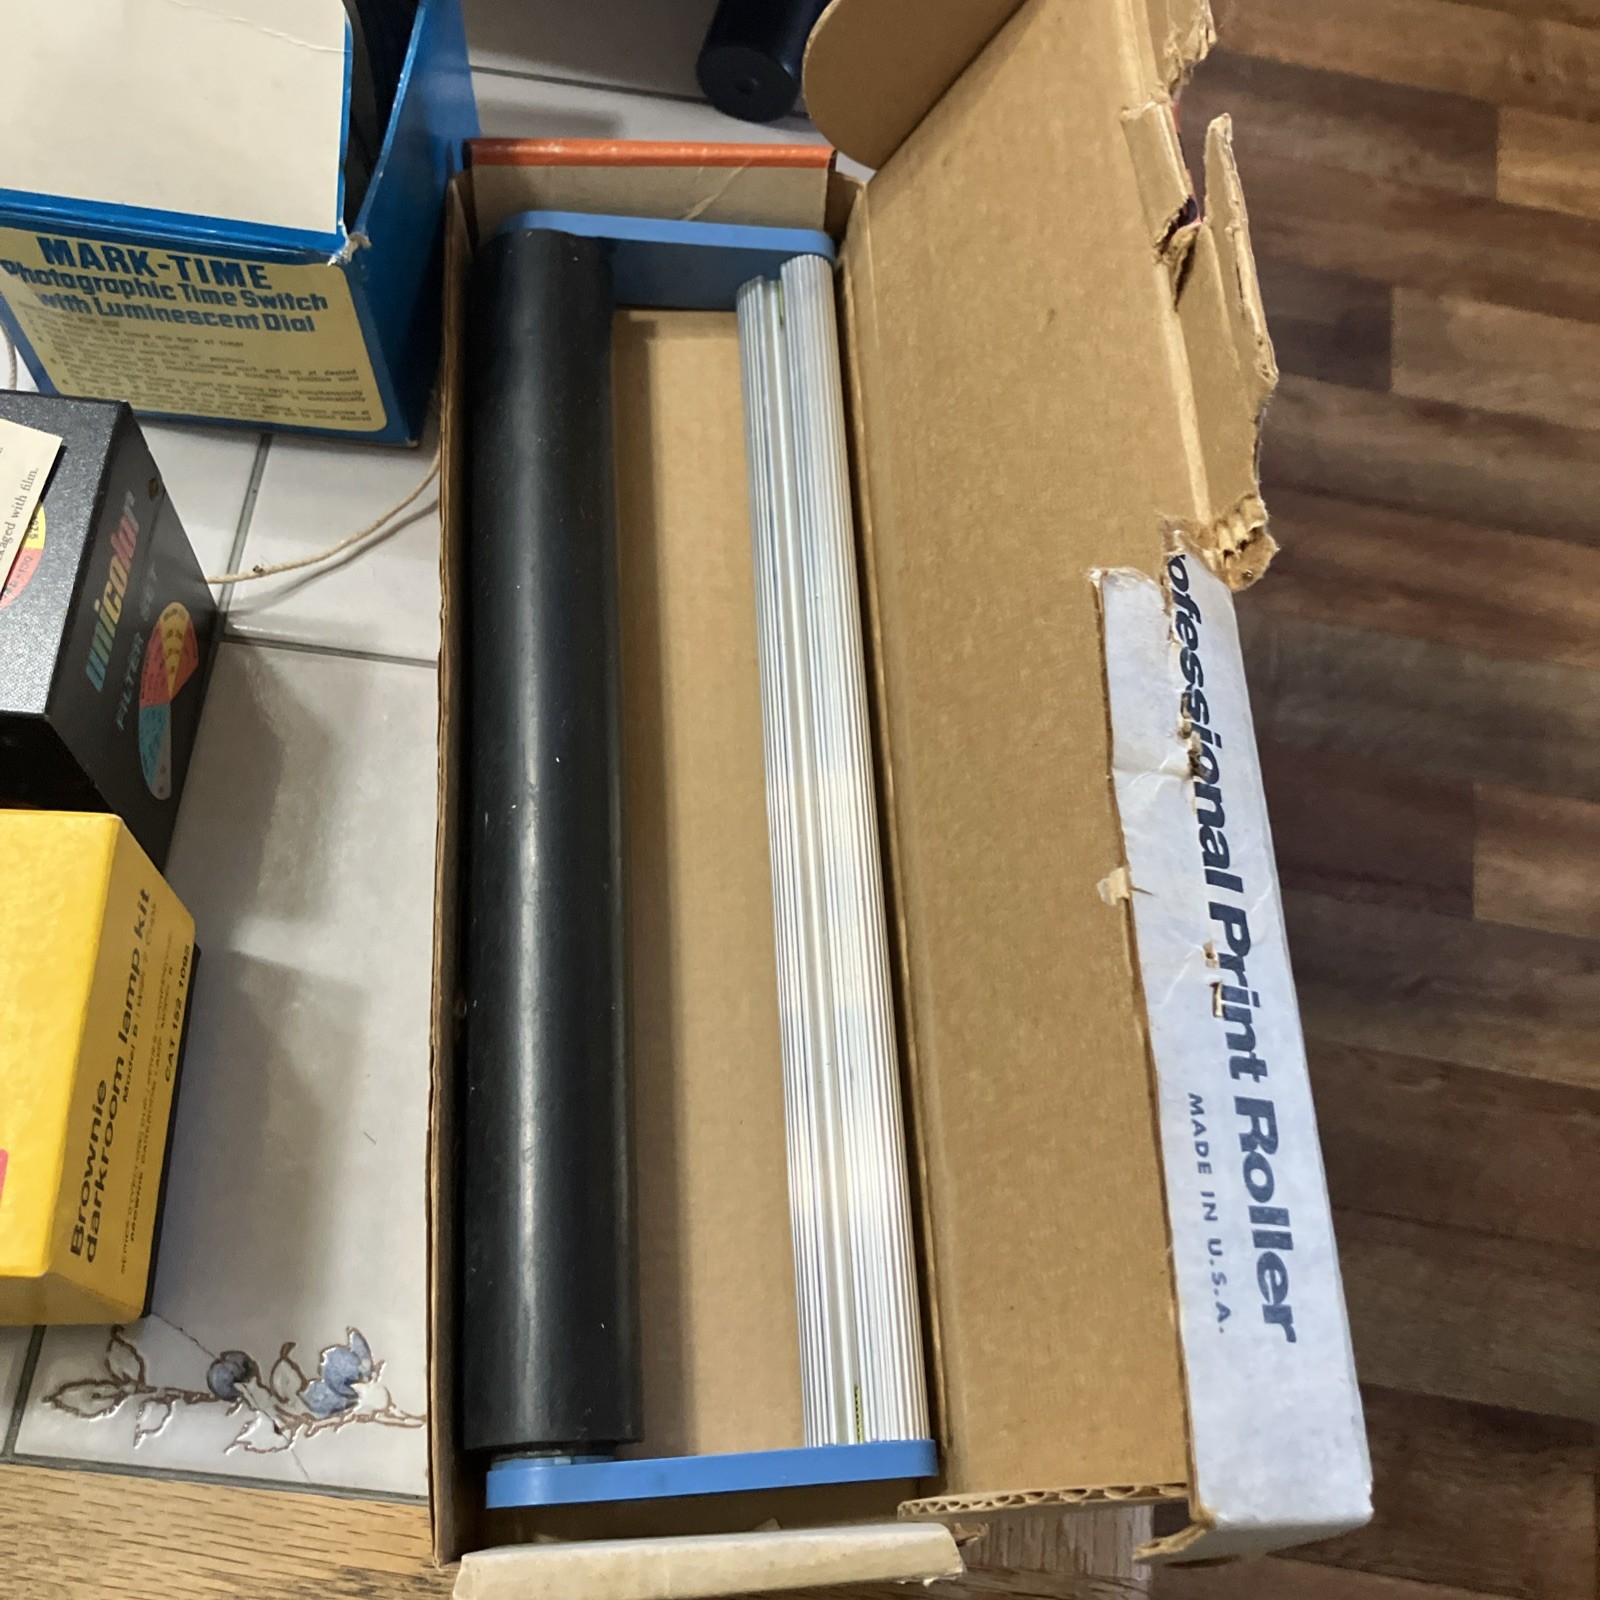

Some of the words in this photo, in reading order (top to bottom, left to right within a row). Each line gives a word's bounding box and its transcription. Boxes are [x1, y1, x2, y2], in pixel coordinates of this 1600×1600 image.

[36, 236, 272, 290] MARK-TIME
[178, 283, 238, 307] Time
[240, 290, 329, 311] Switch
[37, 293, 92, 314] with
[92, 296, 260, 330] Luminescent
[261, 313, 316, 332] Dial
[12, 496, 28, 518] with
[23, 467, 39, 492] film.
[85, 490, 140, 692] unicolor
[1208, 901, 1268, 1083] Print
[86, 1056, 125, 1263] darkroom
[118, 947, 141, 1044] lamp
[133, 888, 150, 939] kit
[122, 1044, 136, 1104] Model
[70, 1080, 107, 1256] Brownie
[1188, 1092, 1213, 1175] MADE
[1200, 1190, 1218, 1222] IN
[1233, 1096, 1296, 1344] Roller
[1205, 1237, 1231, 1334] U.S.A.
